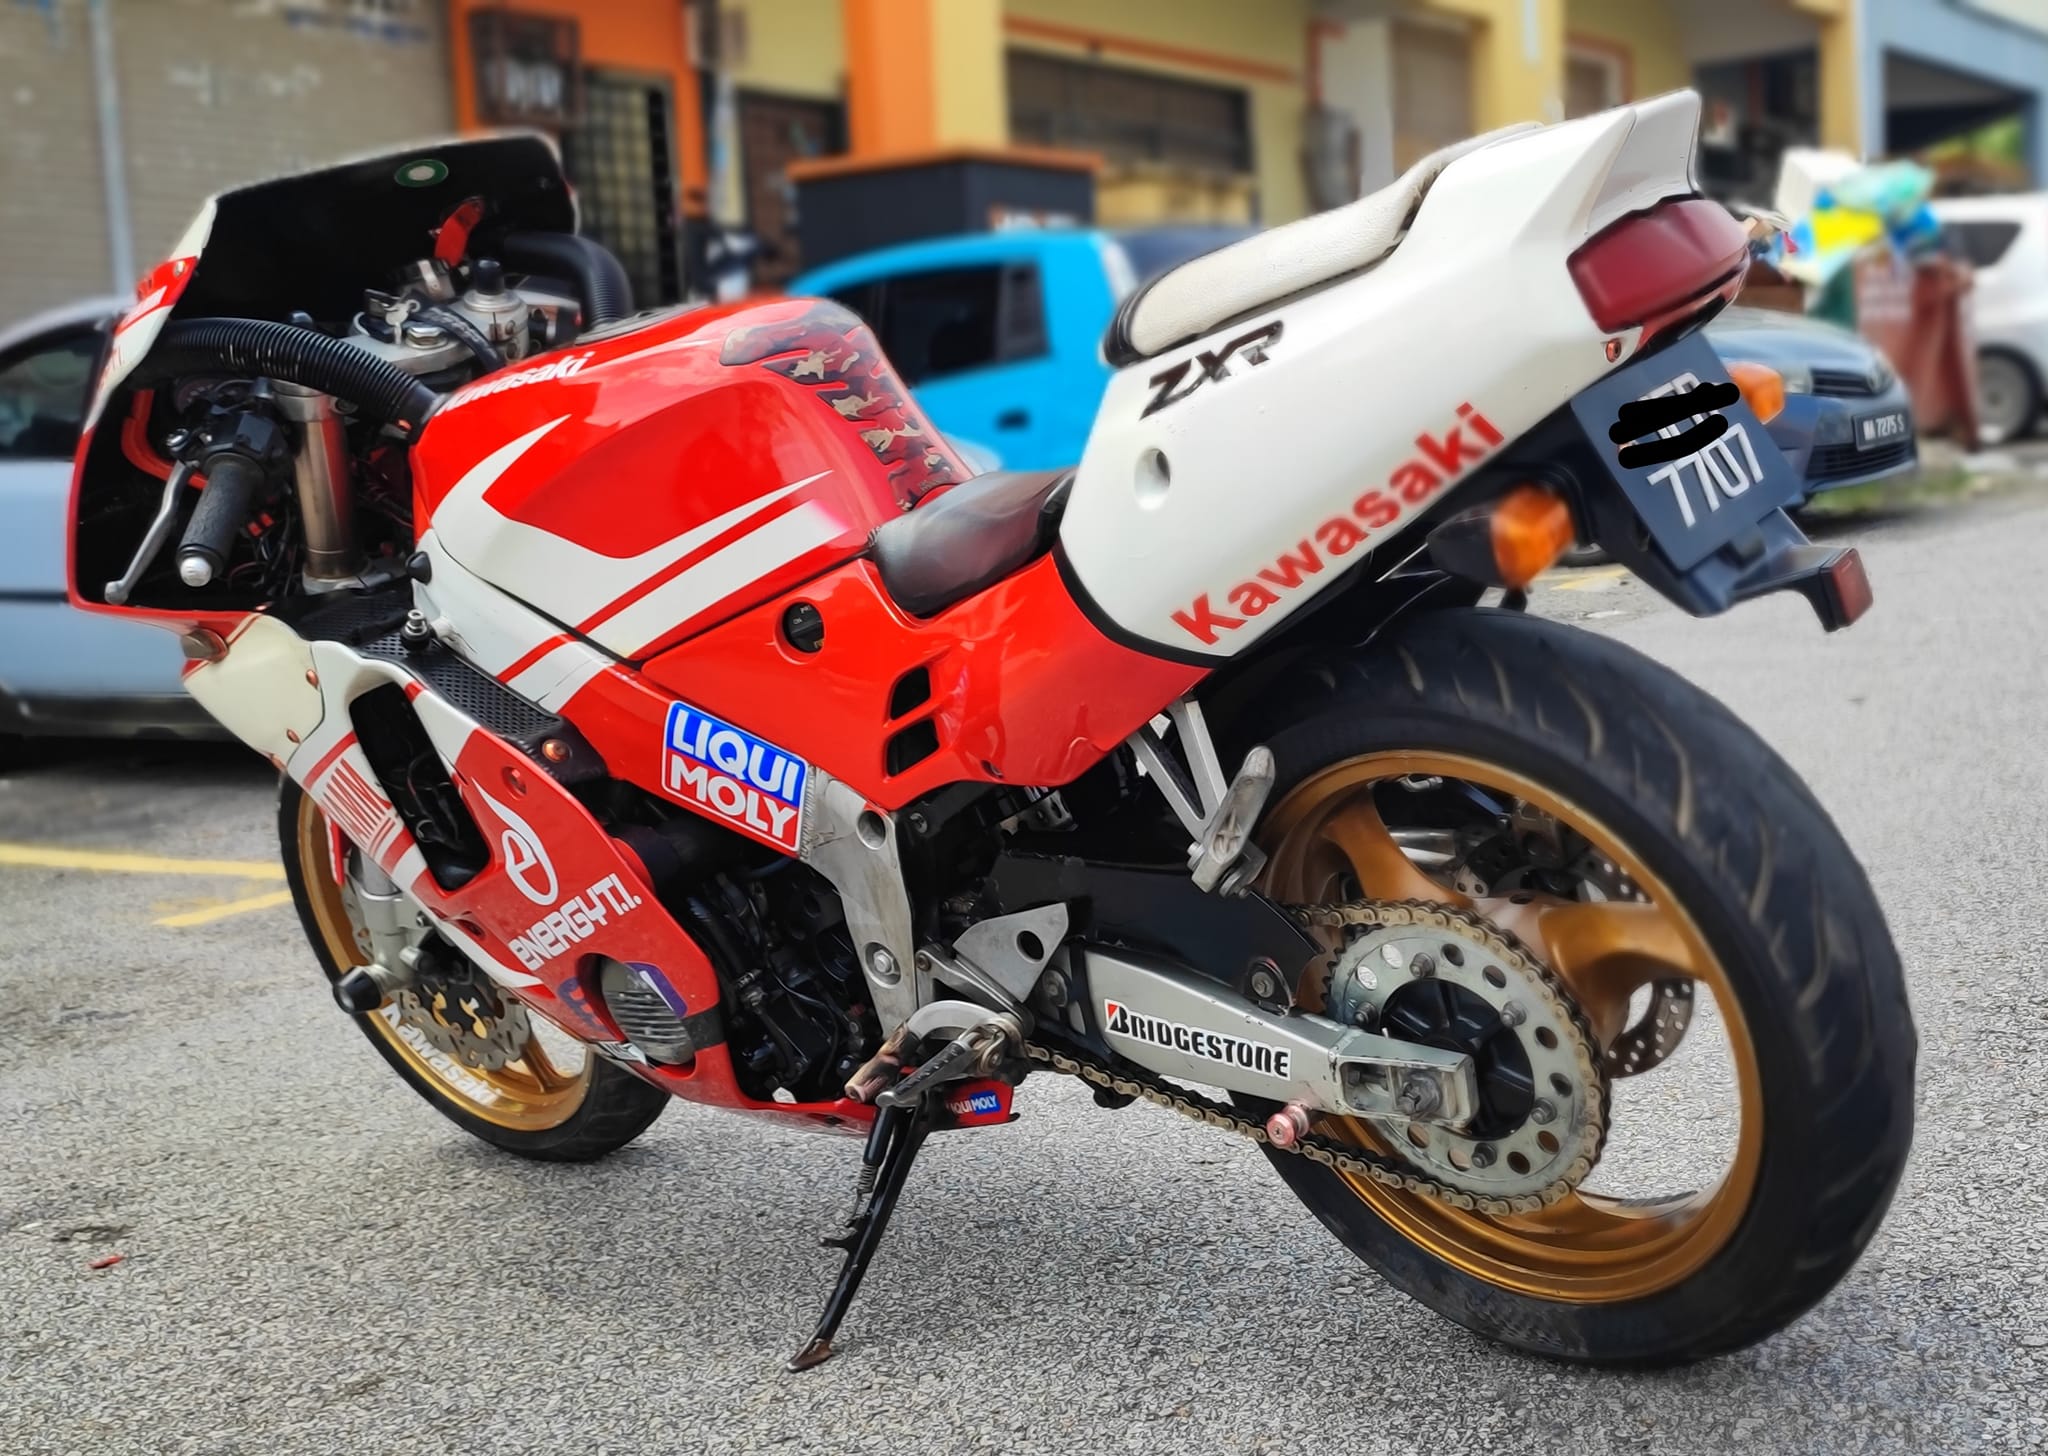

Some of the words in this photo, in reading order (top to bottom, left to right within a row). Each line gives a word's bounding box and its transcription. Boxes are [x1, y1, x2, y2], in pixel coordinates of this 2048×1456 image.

[1169, 401, 1505, 646] Kawasaki
[1646, 422, 1765, 530] 7707
[670, 752, 797, 839] MOLY
[672, 708, 800, 802] LIQUI
[379, 1002, 503, 1107] Kawasaki
[1109, 1004, 1289, 1077] BRIDGESTONE
